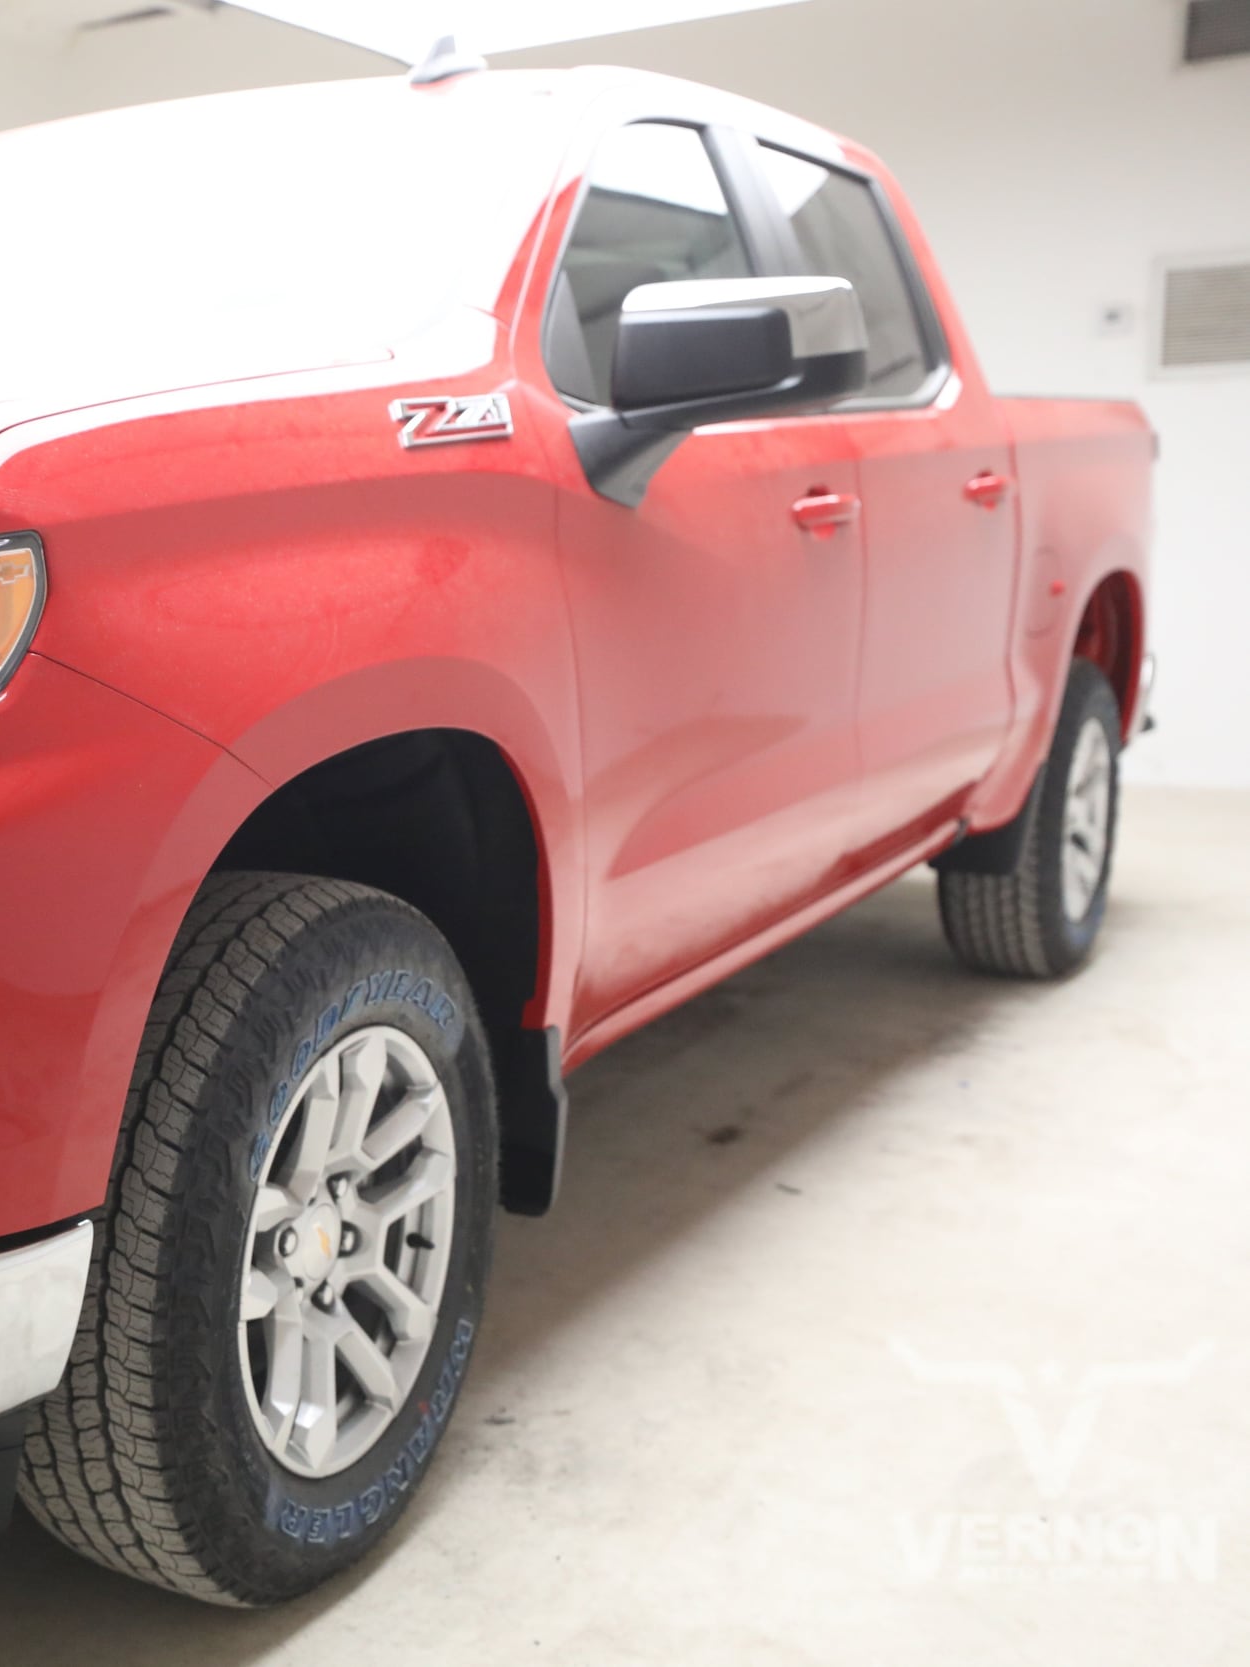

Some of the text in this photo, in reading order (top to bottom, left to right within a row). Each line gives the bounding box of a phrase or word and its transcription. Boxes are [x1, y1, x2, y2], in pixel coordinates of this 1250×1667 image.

[388, 392, 513, 448] Z71
[250, 969, 455, 1181] GOODYEAR
[280, 1318, 475, 1543] WRANGLER
